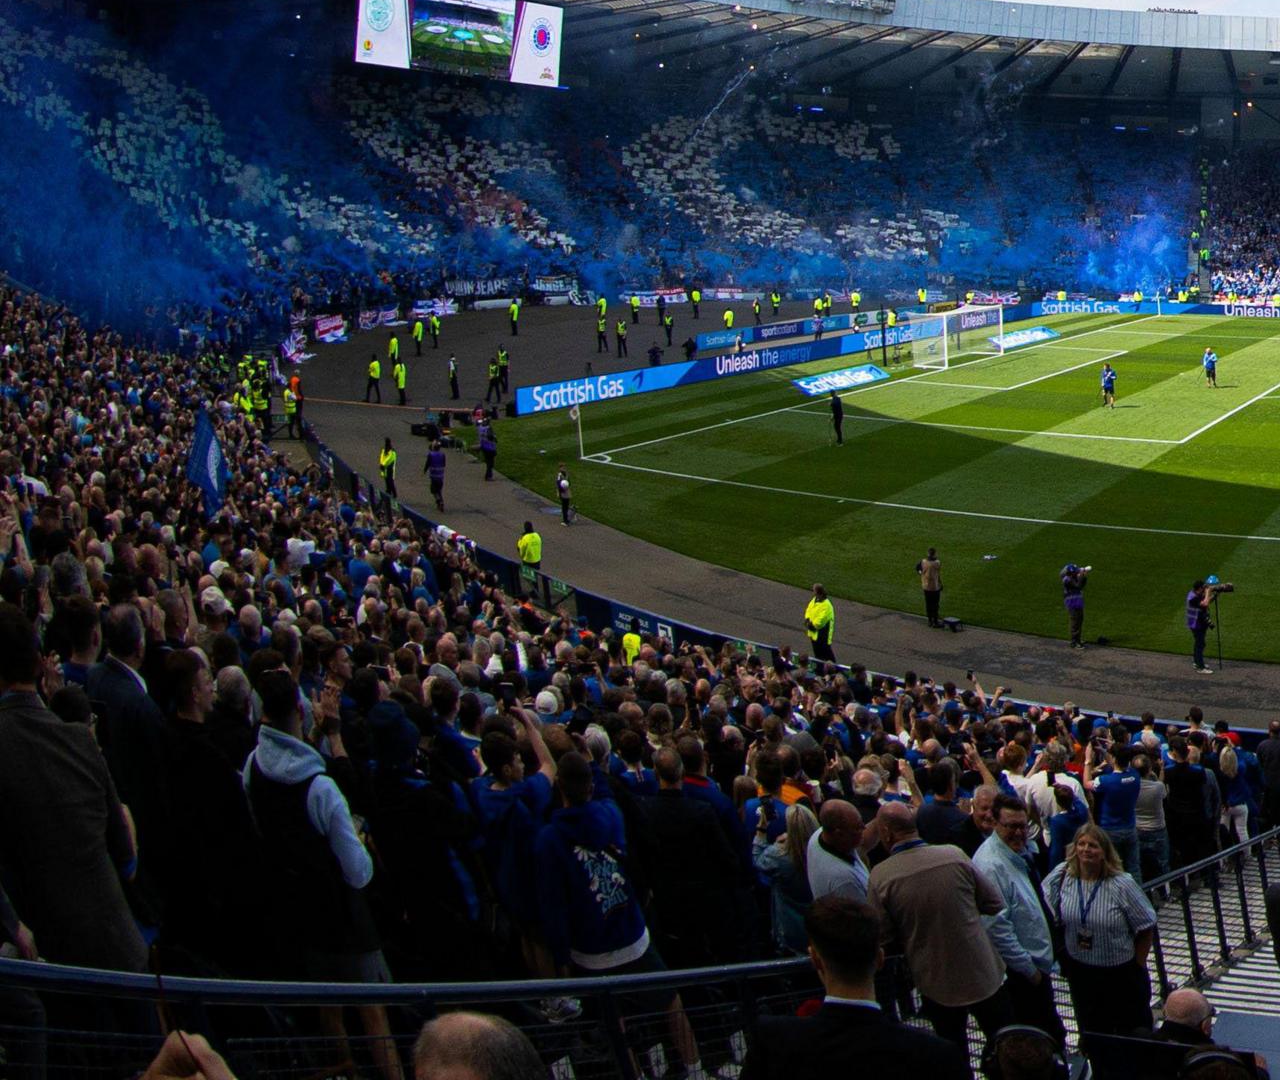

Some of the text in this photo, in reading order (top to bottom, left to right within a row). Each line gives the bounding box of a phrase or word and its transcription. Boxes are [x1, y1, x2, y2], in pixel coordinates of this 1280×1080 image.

[1042, 301, 1121, 314] Scottish Gas
[1224, 304, 1280, 318] Unleash
[716, 345, 812, 375] Unleash the energy
[532, 376, 624, 411] Scottish Gas
